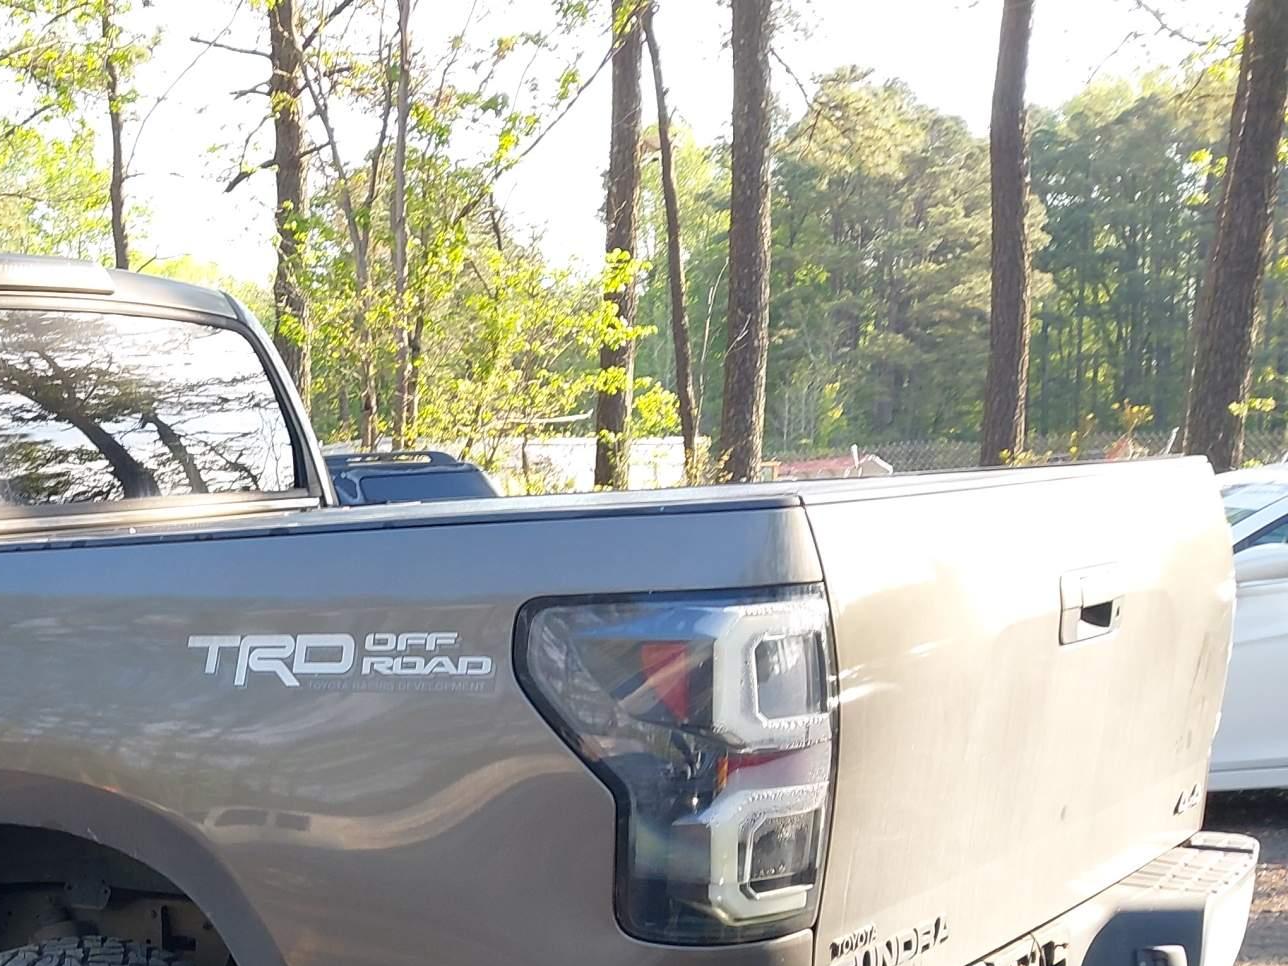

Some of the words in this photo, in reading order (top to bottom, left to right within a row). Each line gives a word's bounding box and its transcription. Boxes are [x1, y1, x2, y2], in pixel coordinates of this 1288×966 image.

[364, 632, 459, 651] OFF
[187, 632, 357, 688] TRD
[362, 655, 495, 675] ROAD
[830, 925, 878, 960] TOYOTA
